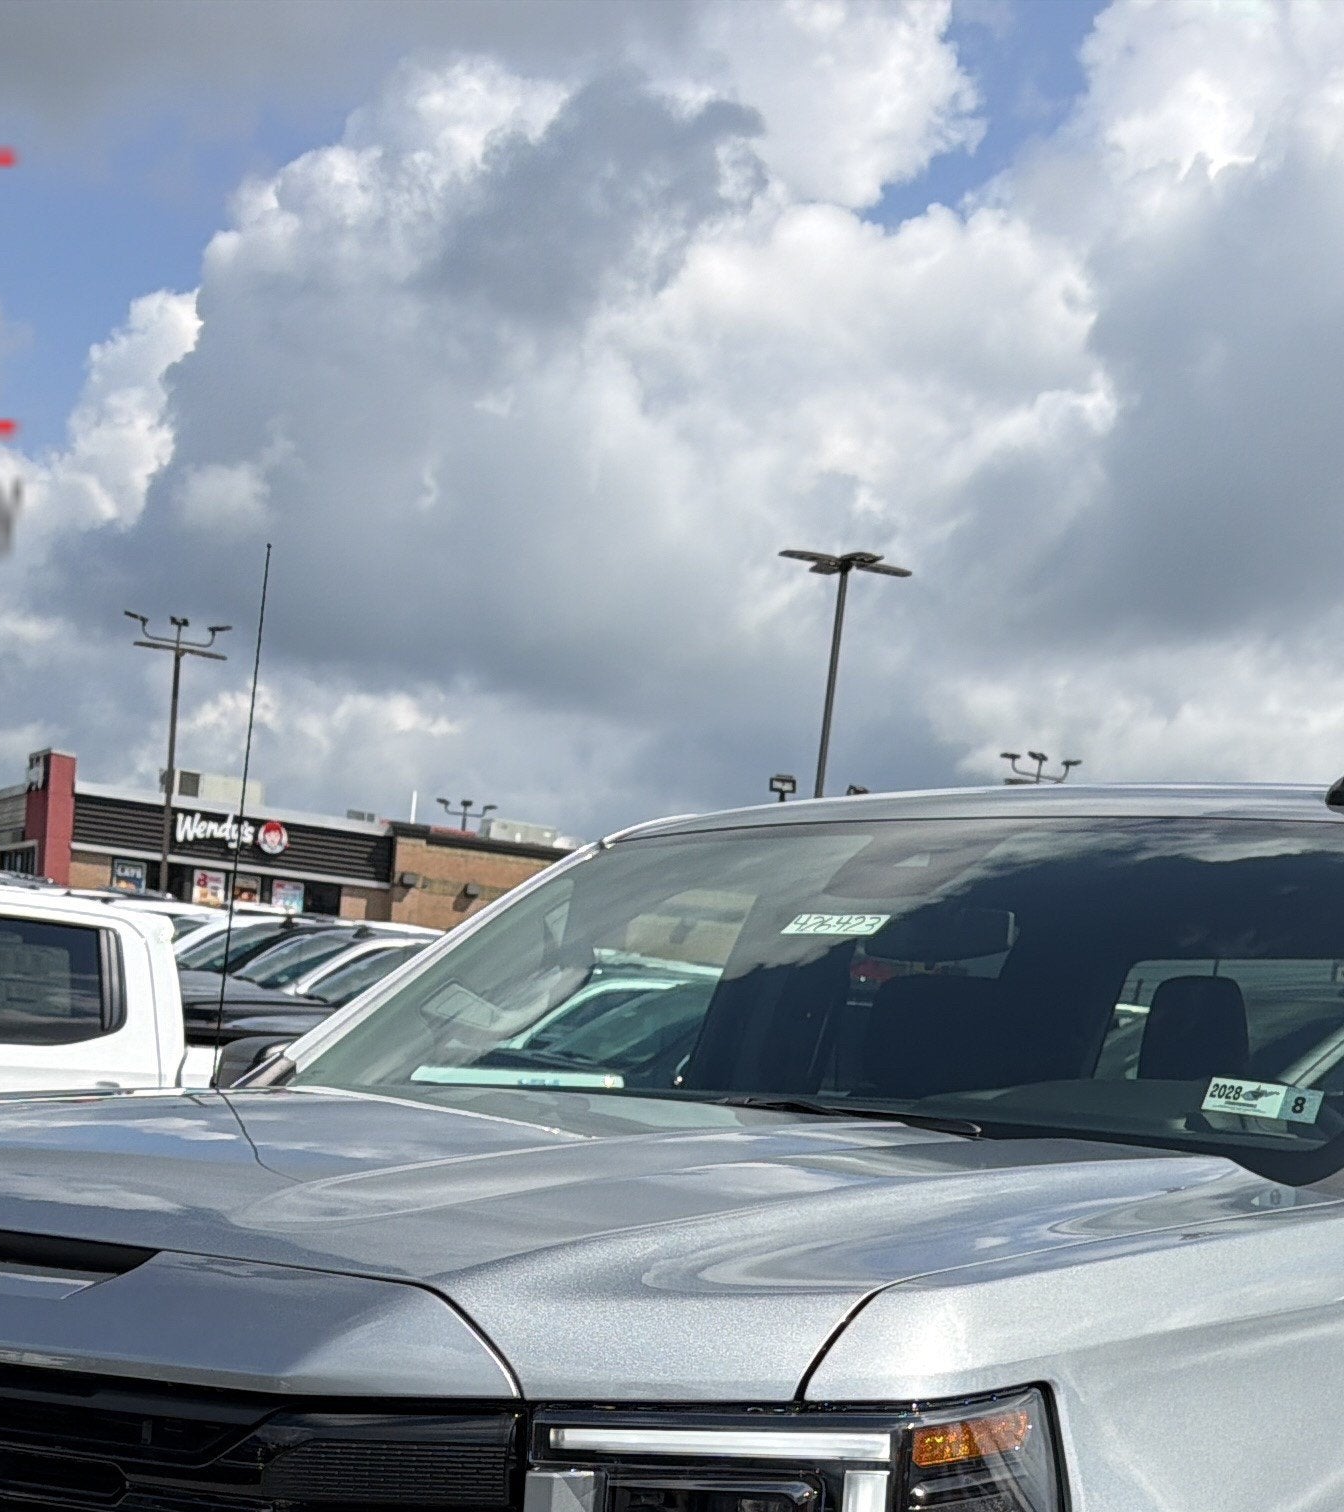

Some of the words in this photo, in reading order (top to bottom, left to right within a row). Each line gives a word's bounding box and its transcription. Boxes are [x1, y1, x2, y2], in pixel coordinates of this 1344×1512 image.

[175, 813, 256, 849] Wendy's
[1208, 1083, 1243, 1101] 2028
[1291, 1096, 1307, 1114] 8
